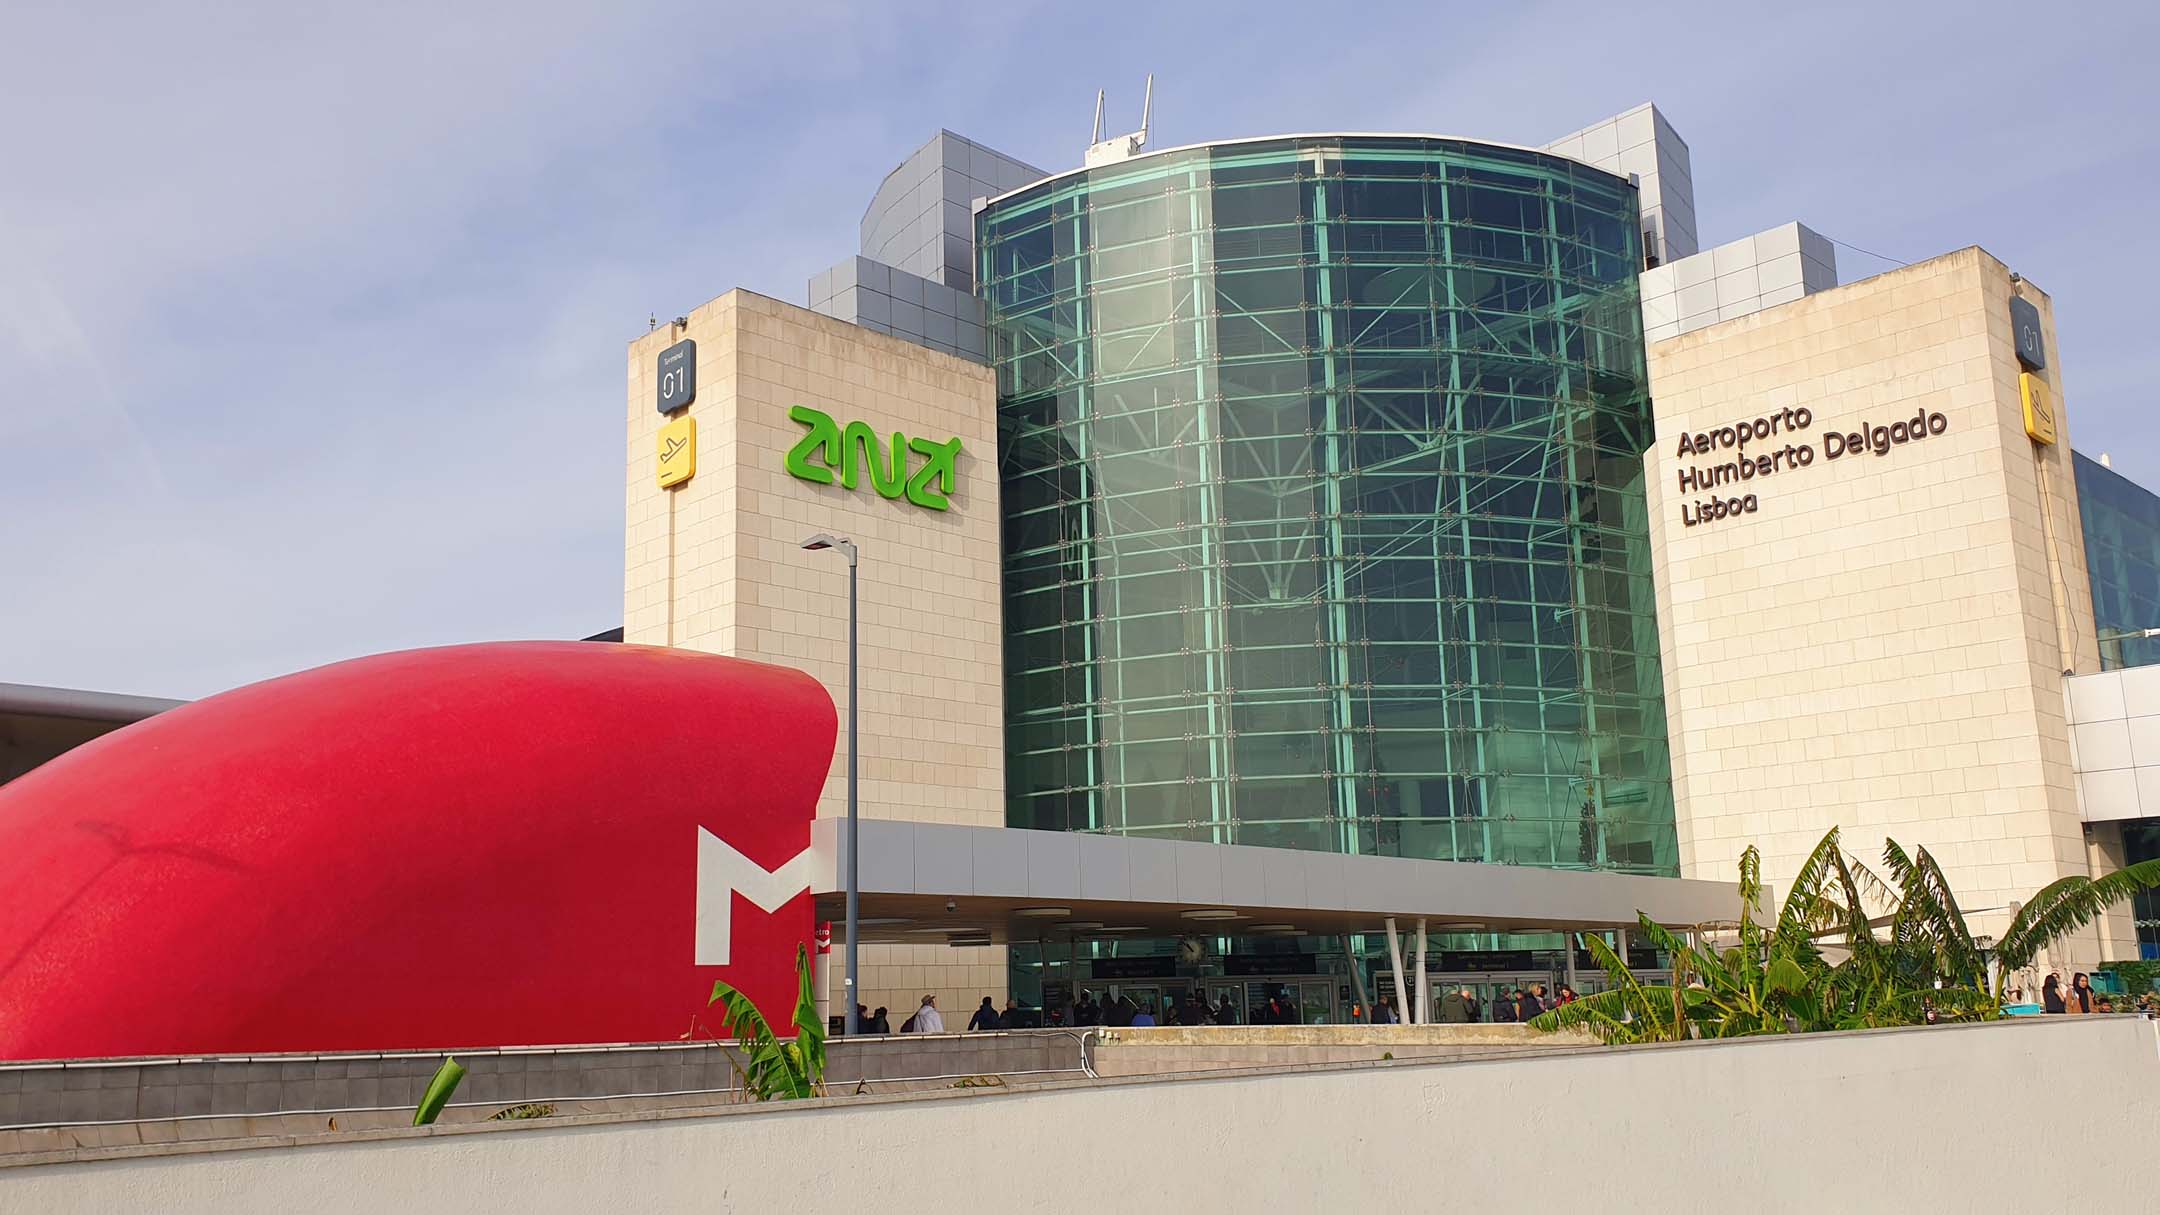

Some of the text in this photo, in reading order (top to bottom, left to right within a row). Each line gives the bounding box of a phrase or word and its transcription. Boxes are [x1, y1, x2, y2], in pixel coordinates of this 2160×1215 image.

[664, 366, 683, 399] 01
[1677, 407, 1812, 460] Aeroporto
[1678, 408, 1948, 494] Humberto Delgado
[1681, 494, 1758, 528] Lisboa
